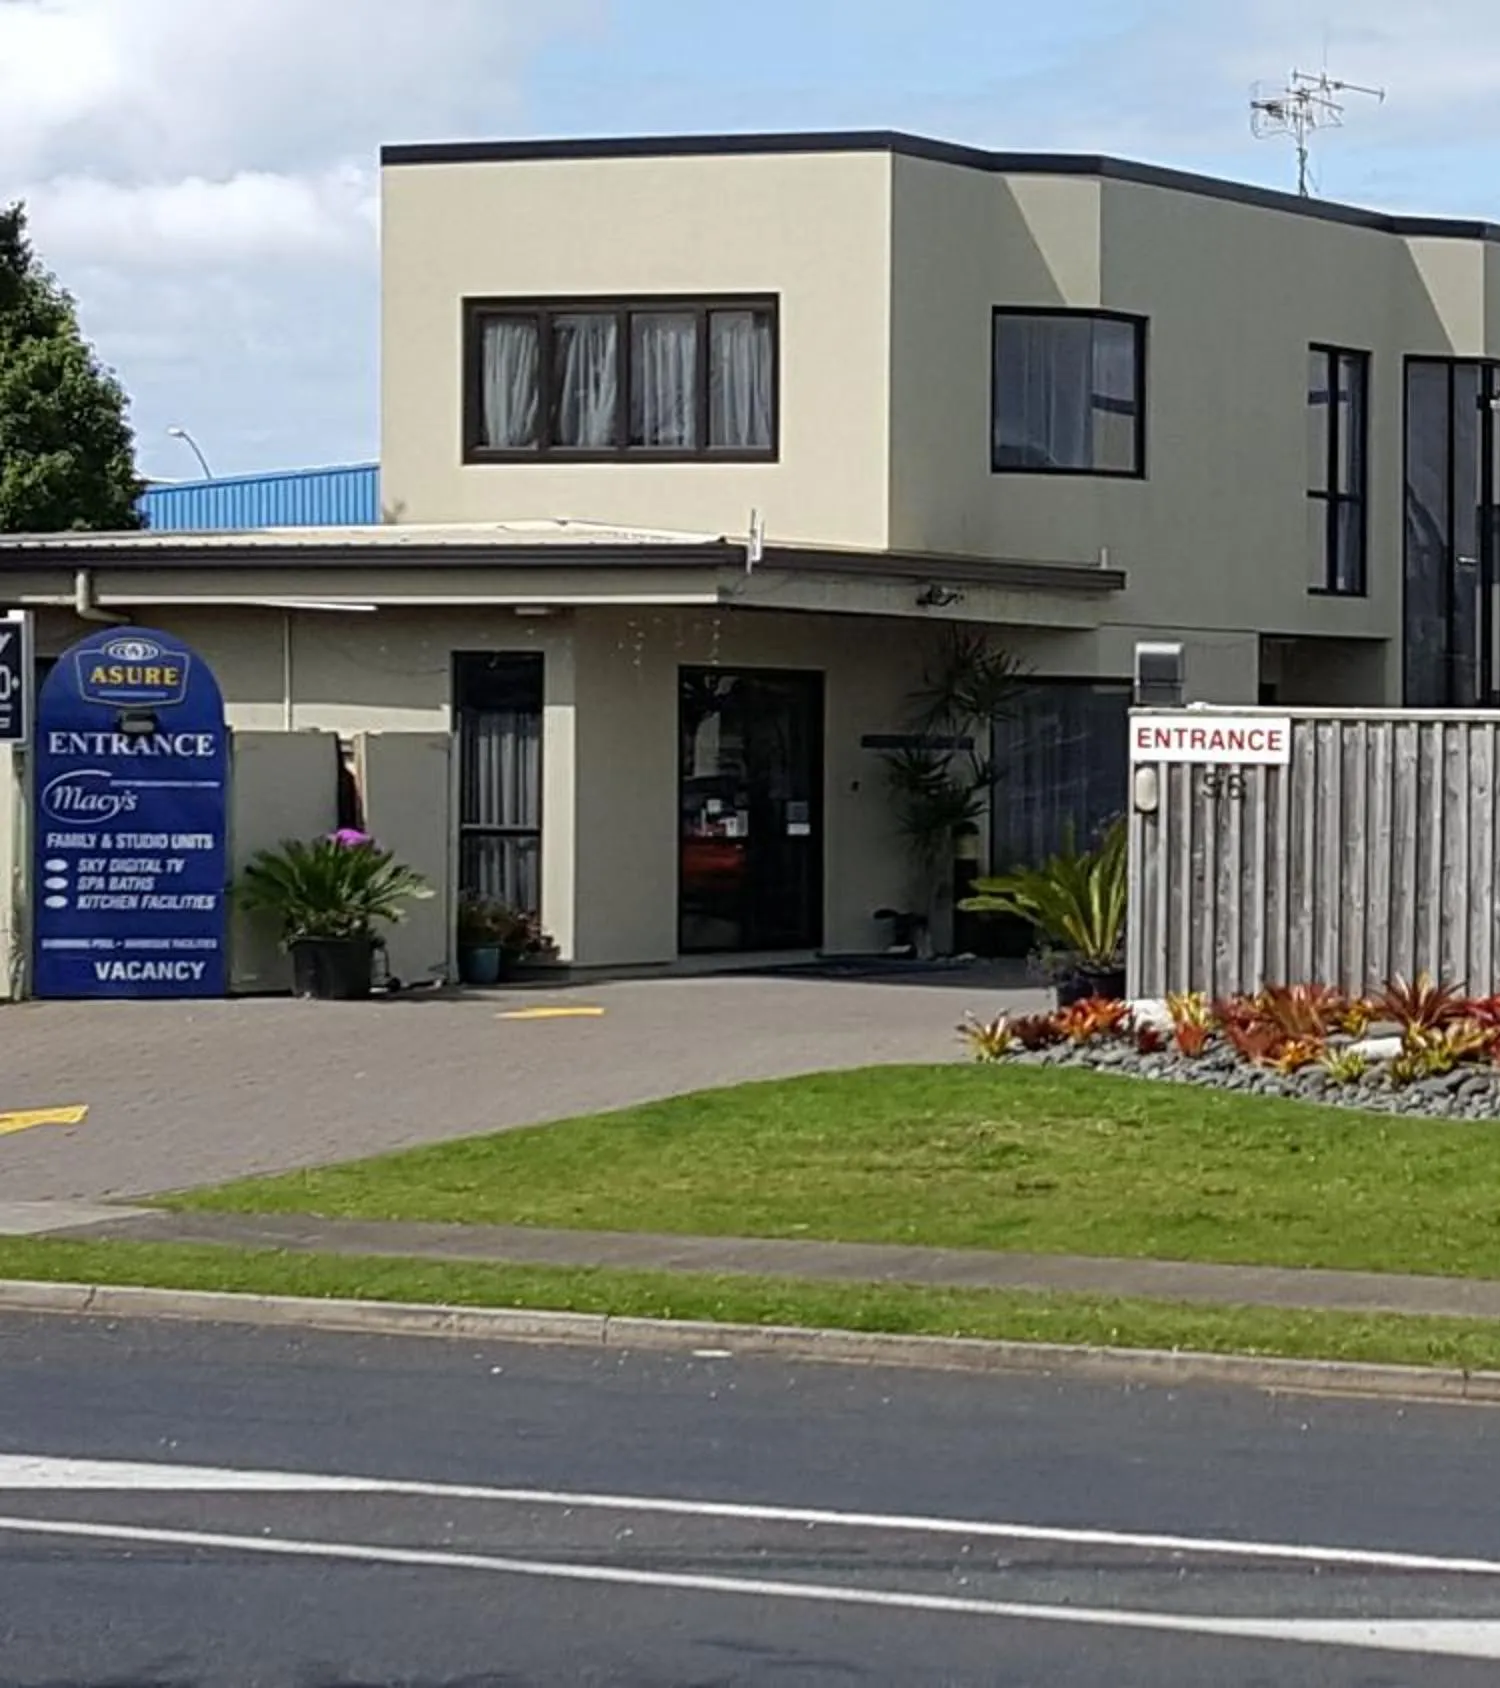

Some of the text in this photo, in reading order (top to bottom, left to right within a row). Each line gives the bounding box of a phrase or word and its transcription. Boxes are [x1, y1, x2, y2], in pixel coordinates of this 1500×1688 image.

[90, 666, 179, 686] ASURE
[48, 731, 216, 756] ENTRANCE
[1136, 727, 1284, 752] ENTRANCE
[51, 784, 139, 824] Macy's
[46, 833, 97, 849] FAMILY
[115, 833, 168, 849] STUDIO
[171, 833, 214, 849] UNITS
[77, 858, 185, 873] SKY DIGITAL TV
[77, 876, 105, 891] SPA
[76, 895, 216, 910] KITCHEN FACILITIES
[94, 961, 205, 981] VACANCY
